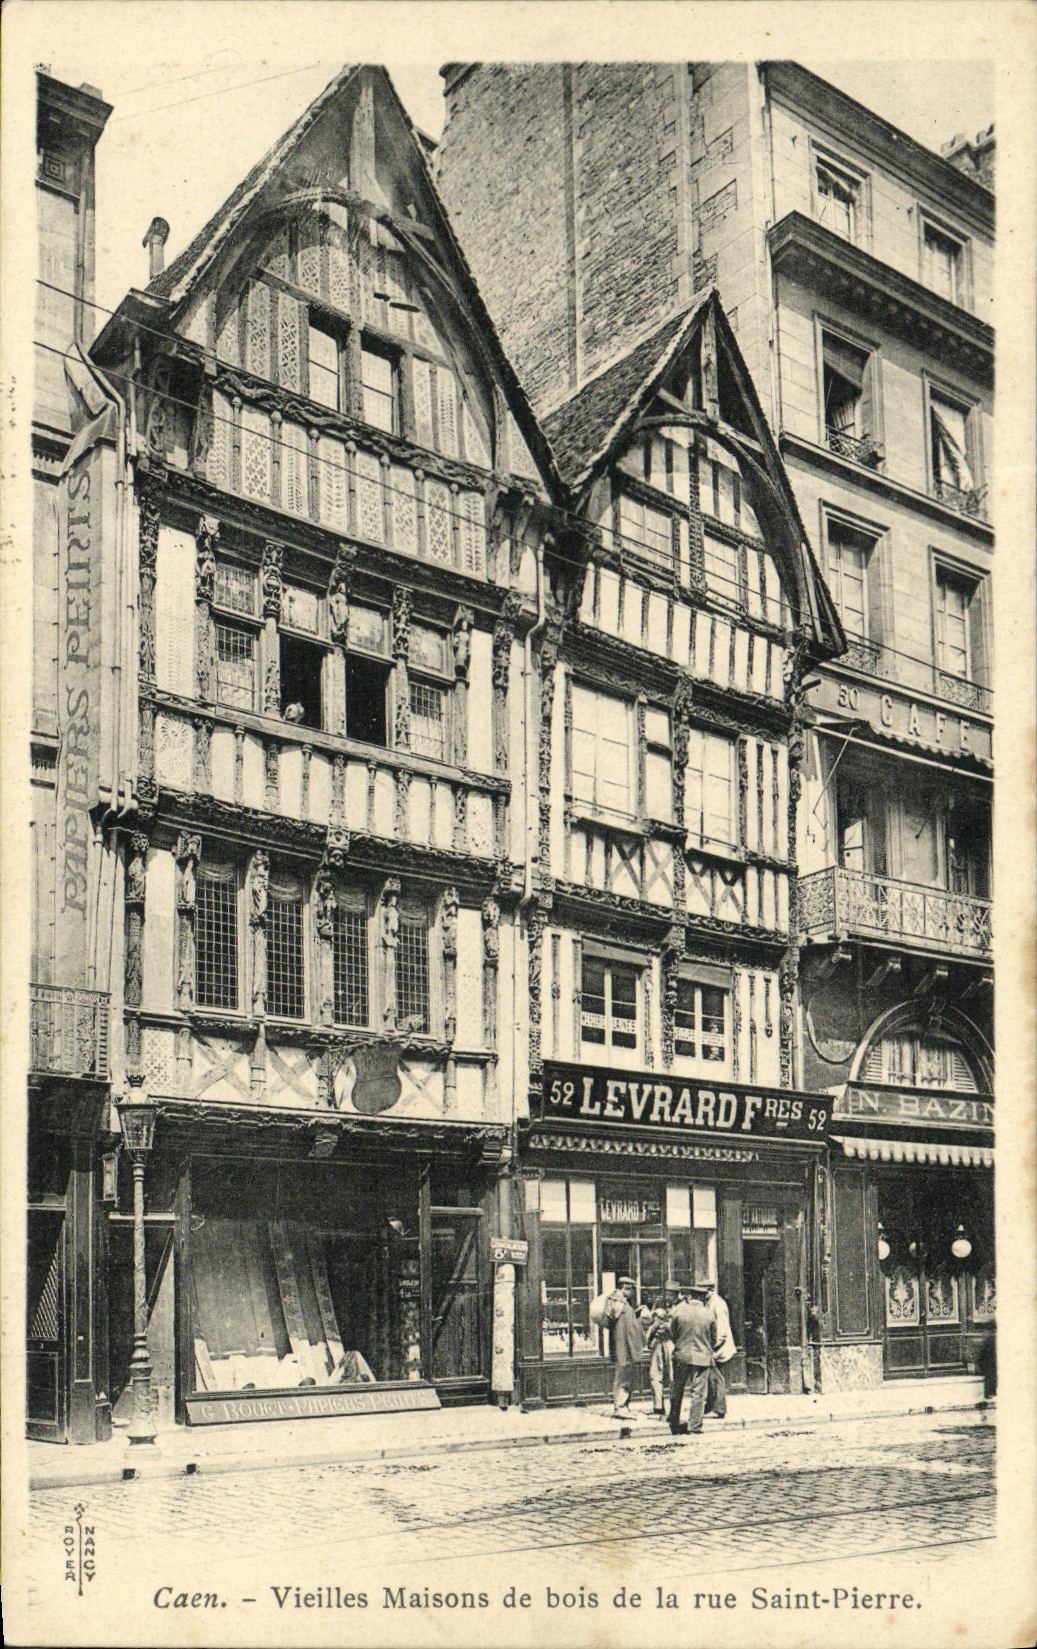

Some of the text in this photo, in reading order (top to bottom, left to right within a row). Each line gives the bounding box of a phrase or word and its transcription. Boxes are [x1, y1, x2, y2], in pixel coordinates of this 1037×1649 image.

[61, 468, 92, 920] PAPIERS PEINTS
[837, 684, 860, 712] 50
[550, 1080, 575, 1105] 52
[580, 1076, 737, 1129] LEVRARD
[807, 1108, 827, 1131] 52
[296, 1394, 366, 1416] PAPIERS
